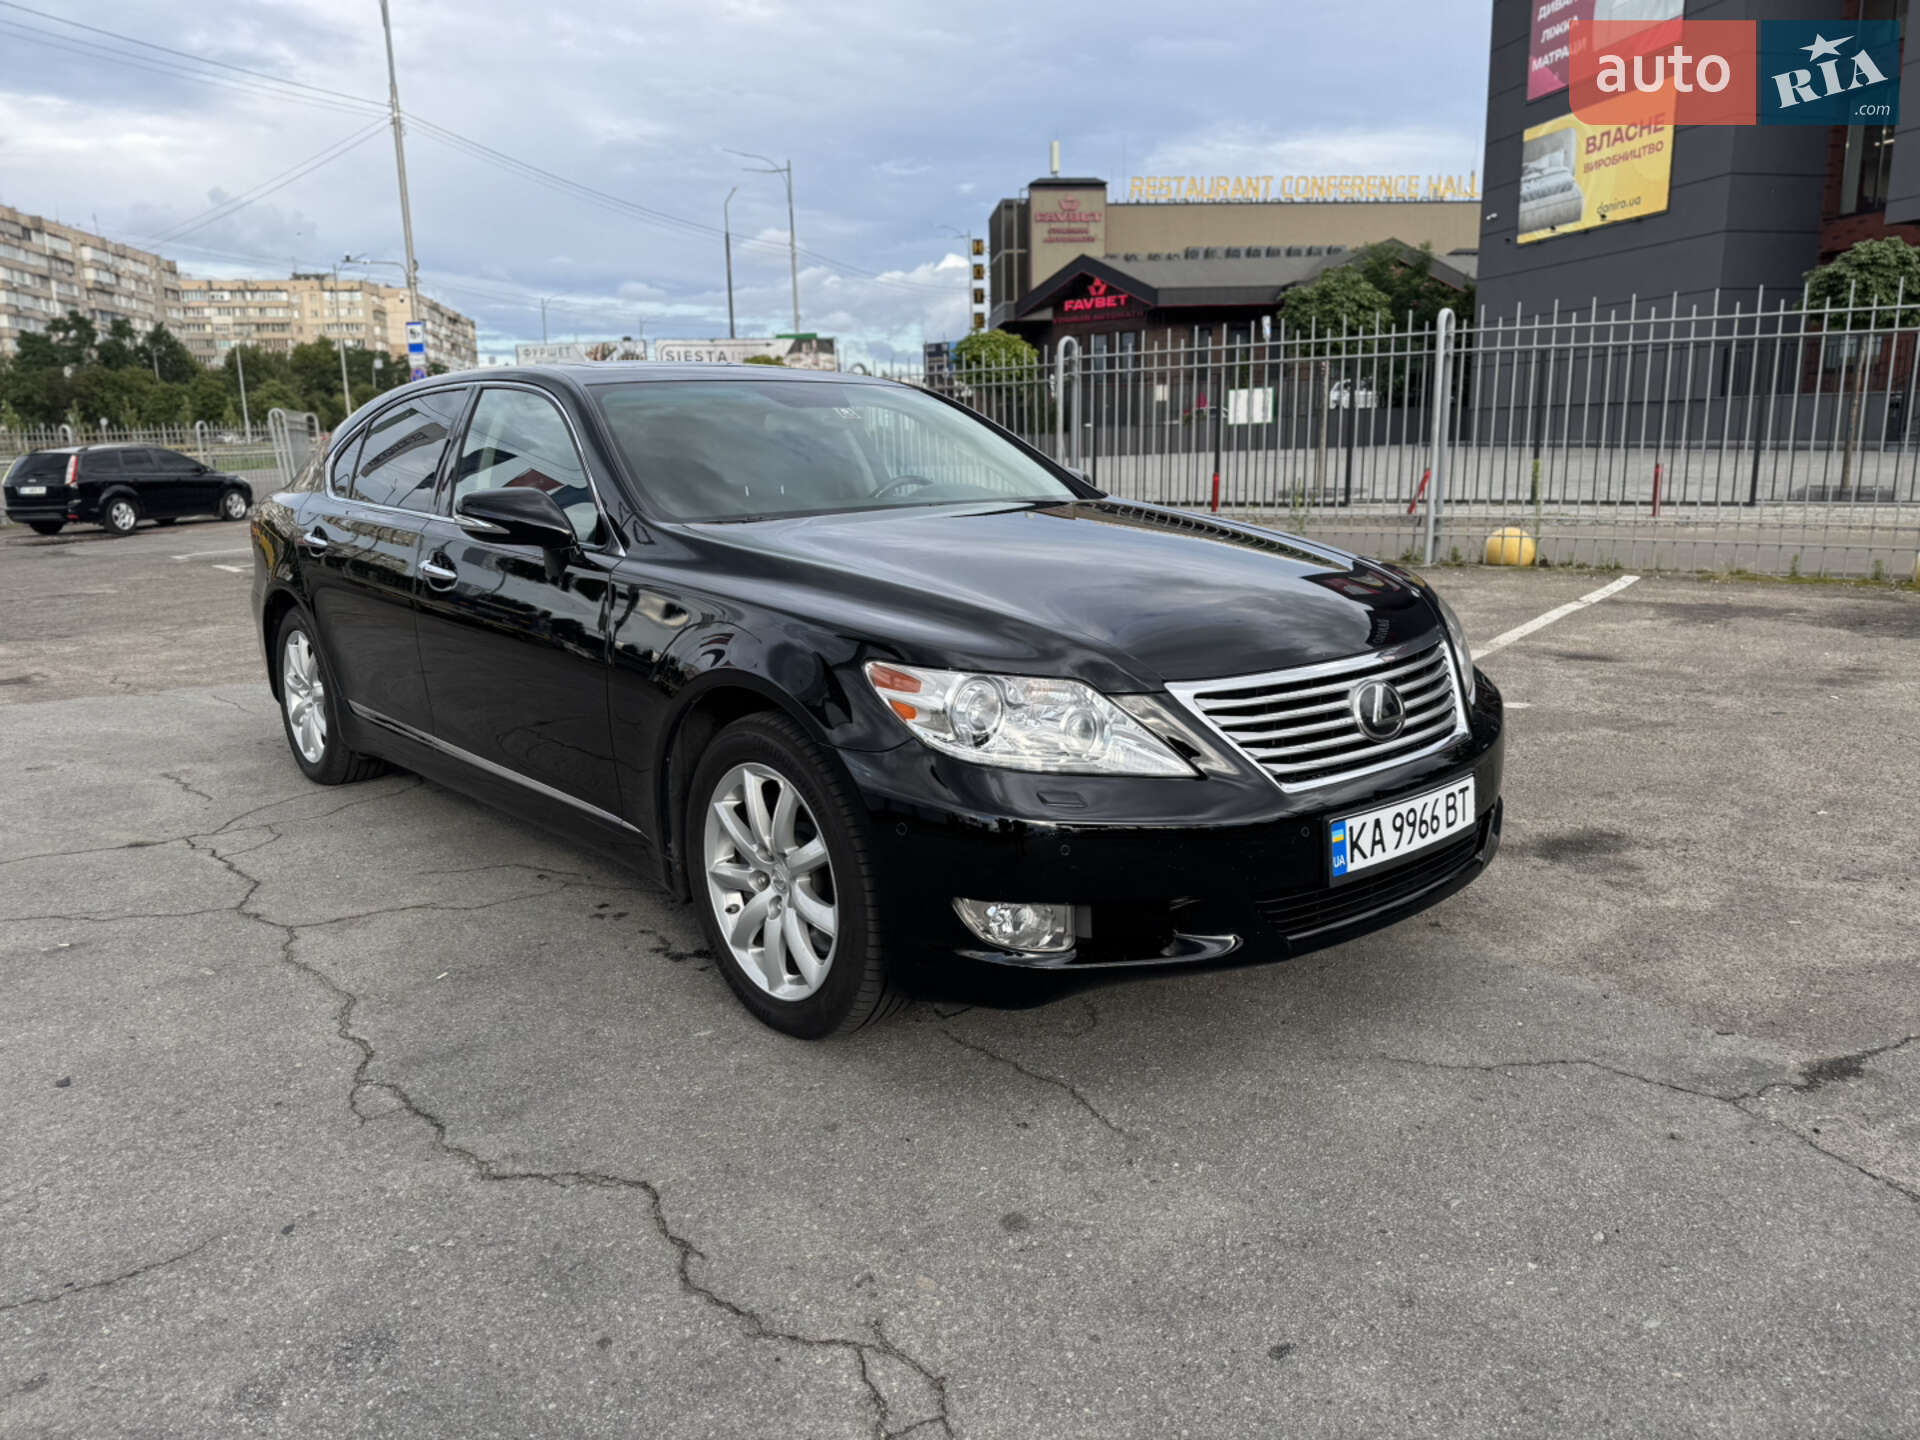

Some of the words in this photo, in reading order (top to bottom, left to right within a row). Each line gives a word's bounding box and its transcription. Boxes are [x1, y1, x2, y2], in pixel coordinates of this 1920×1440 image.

[1585, 112, 1665, 155] ВЛАСНЕ
[1583, 140, 1664, 173] ВИРОБНИЦТВО
[1129, 175, 1273, 199] RESTAURANT
[1281, 175, 1421, 199] CONFERENCE
[1428, 175, 1481, 198] HALL
[1063, 294, 1129, 312] FAVBET
[665, 350, 728, 362] SIESTA
[1349, 818, 1387, 863] KA
[1392, 798, 1440, 850] 9966
[1446, 786, 1470, 829] BT
[1333, 855, 1346, 868] UA
